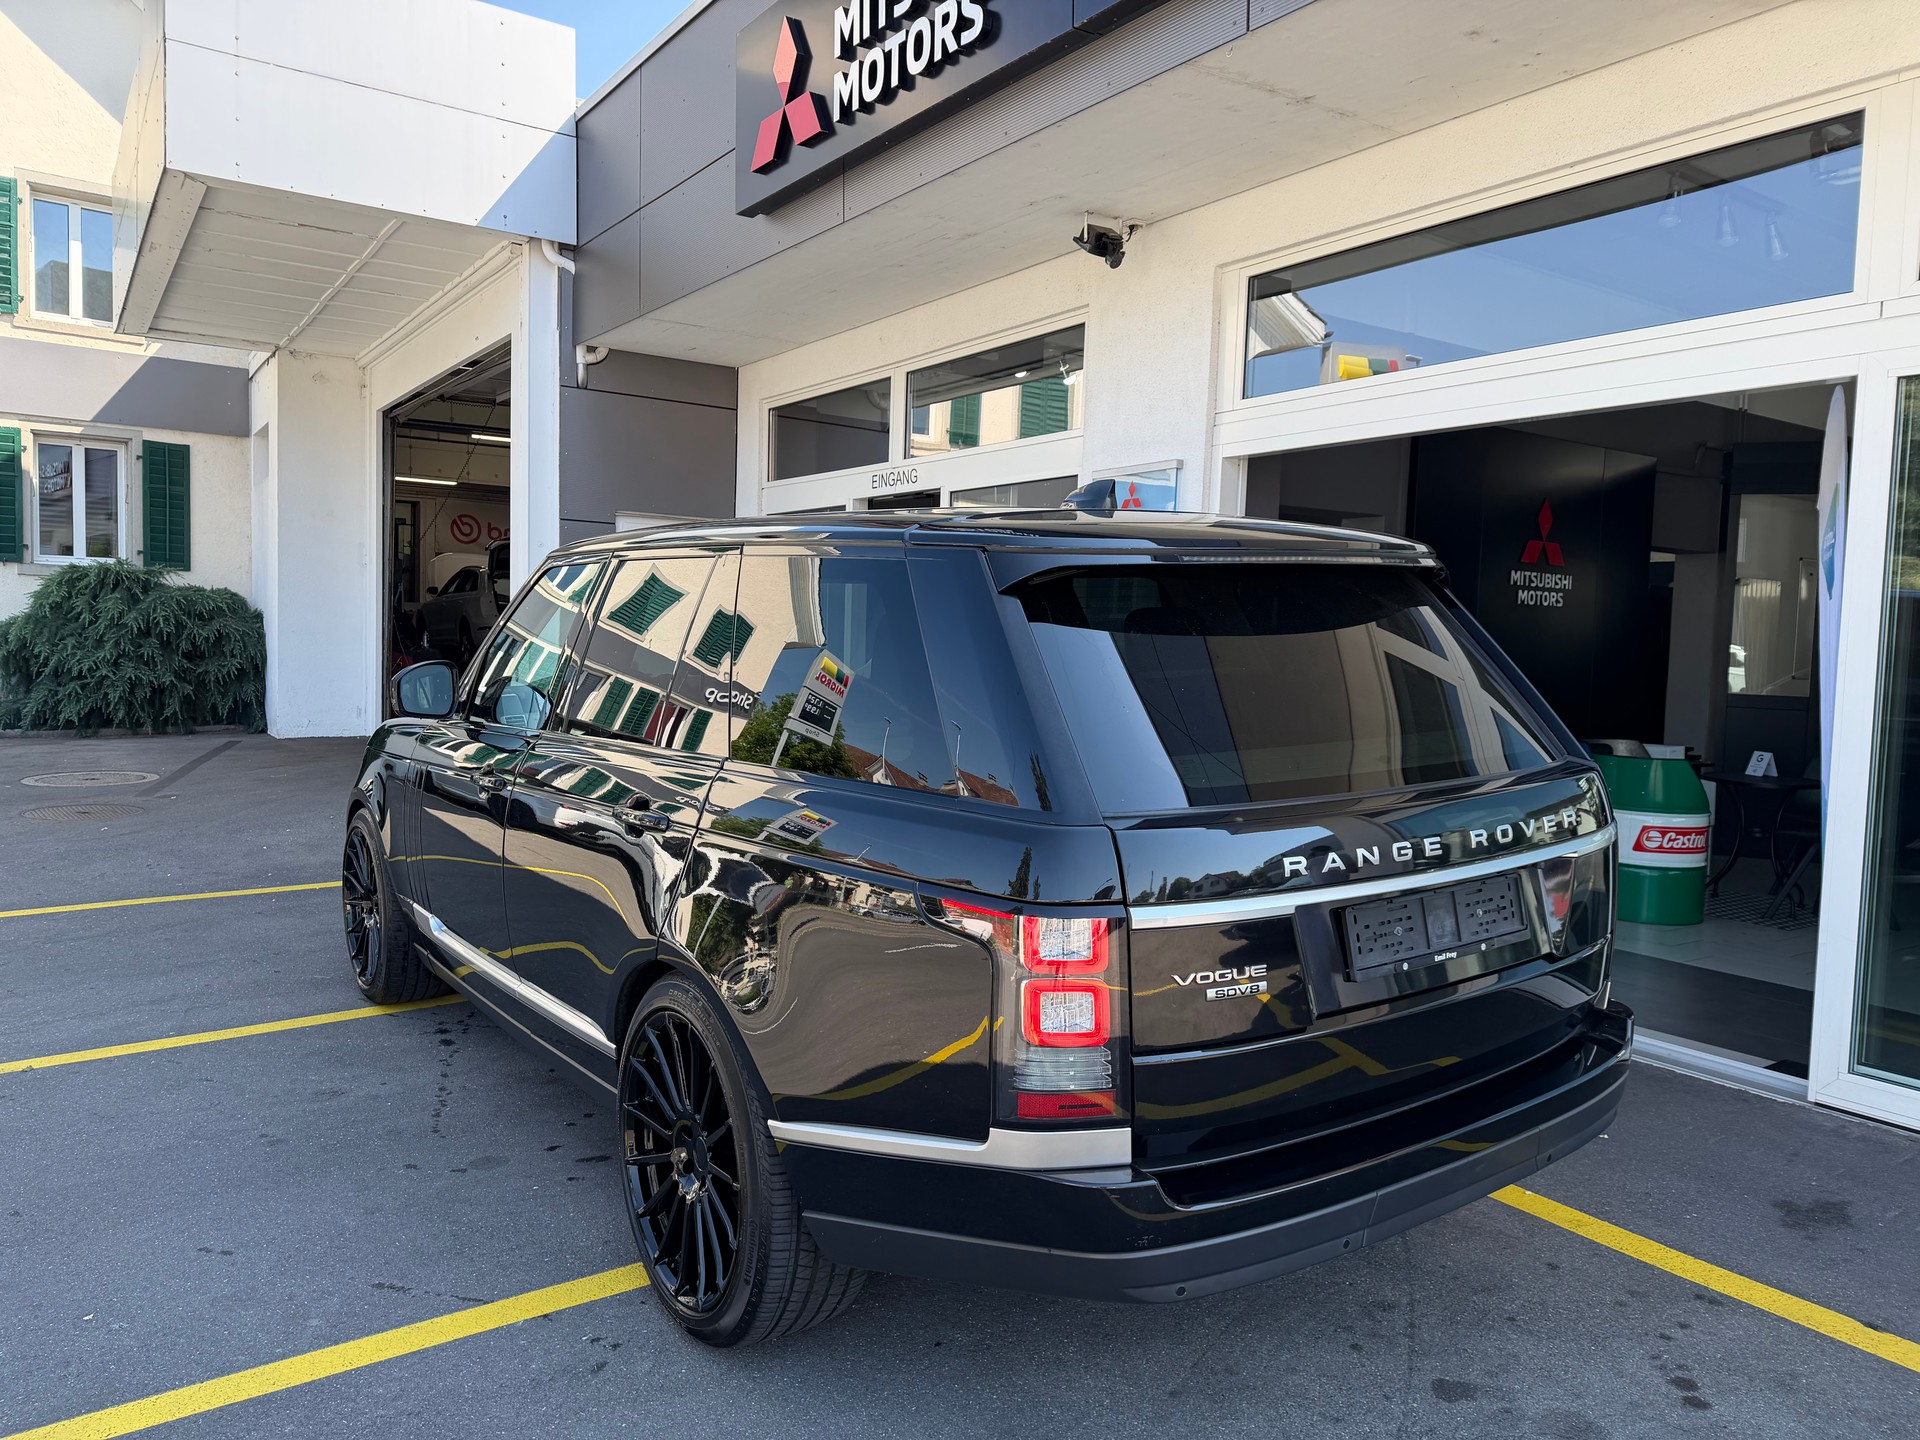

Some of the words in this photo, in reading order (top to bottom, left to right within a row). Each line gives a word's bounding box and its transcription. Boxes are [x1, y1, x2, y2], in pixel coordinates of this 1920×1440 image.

[833, 0, 984, 123] MOTORS
[871, 468, 918, 489] EINGANG
[1510, 569, 1573, 590] MITSUBISHI
[1517, 589, 1564, 607] MOTORS
[1283, 836, 1443, 878] RANGE
[1468, 809, 1579, 849] ROVER
[1662, 832, 1707, 849] Castrol
[1170, 964, 1268, 986] VOGUE
[1215, 984, 1260, 999] SDV8
